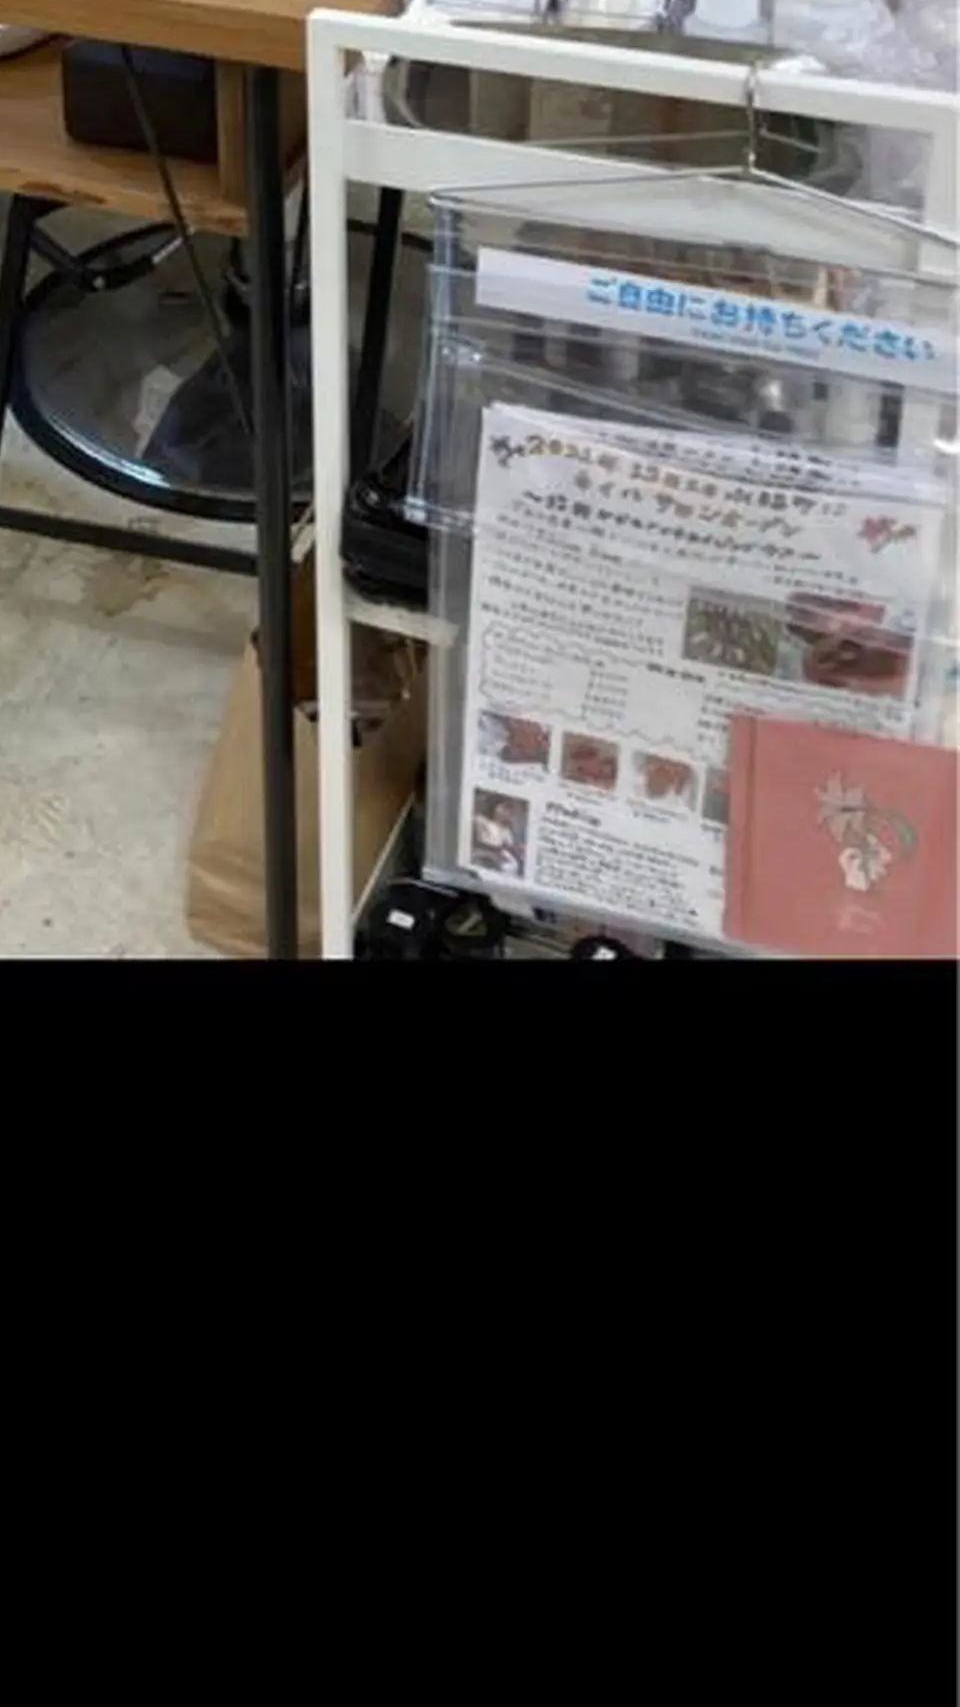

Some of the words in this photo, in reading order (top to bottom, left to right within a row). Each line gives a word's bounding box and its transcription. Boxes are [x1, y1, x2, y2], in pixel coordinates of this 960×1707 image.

[587, 276, 937, 362] ご自由にお持ちください
